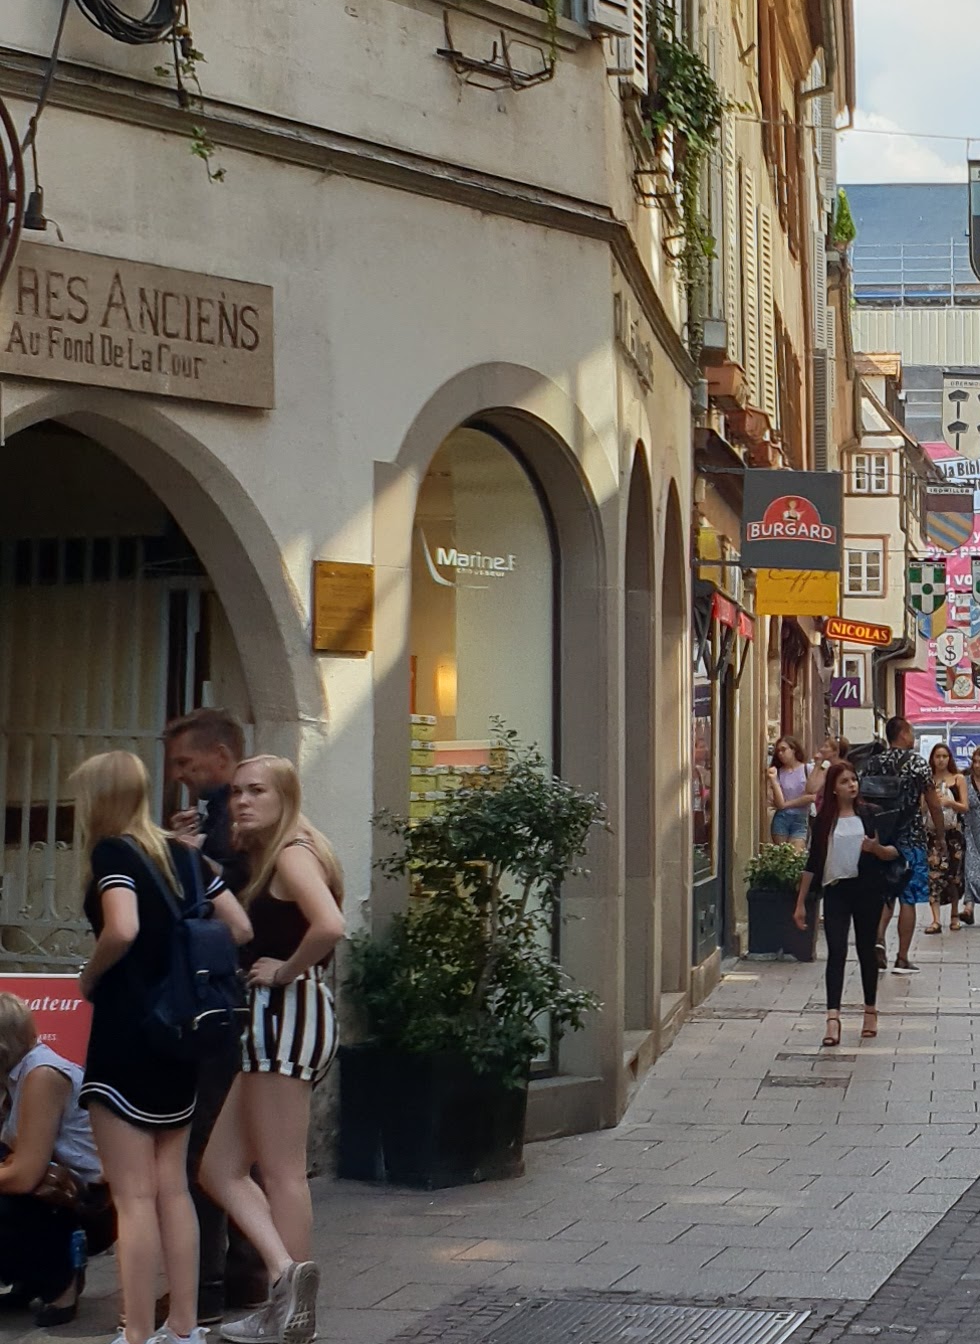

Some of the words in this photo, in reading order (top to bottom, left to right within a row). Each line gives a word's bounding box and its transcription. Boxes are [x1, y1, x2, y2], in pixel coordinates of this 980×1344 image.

[48, 325, 95, 365] Fond
[750, 522, 833, 540] BURGARD
[831, 621, 889, 643] NICOLAS
